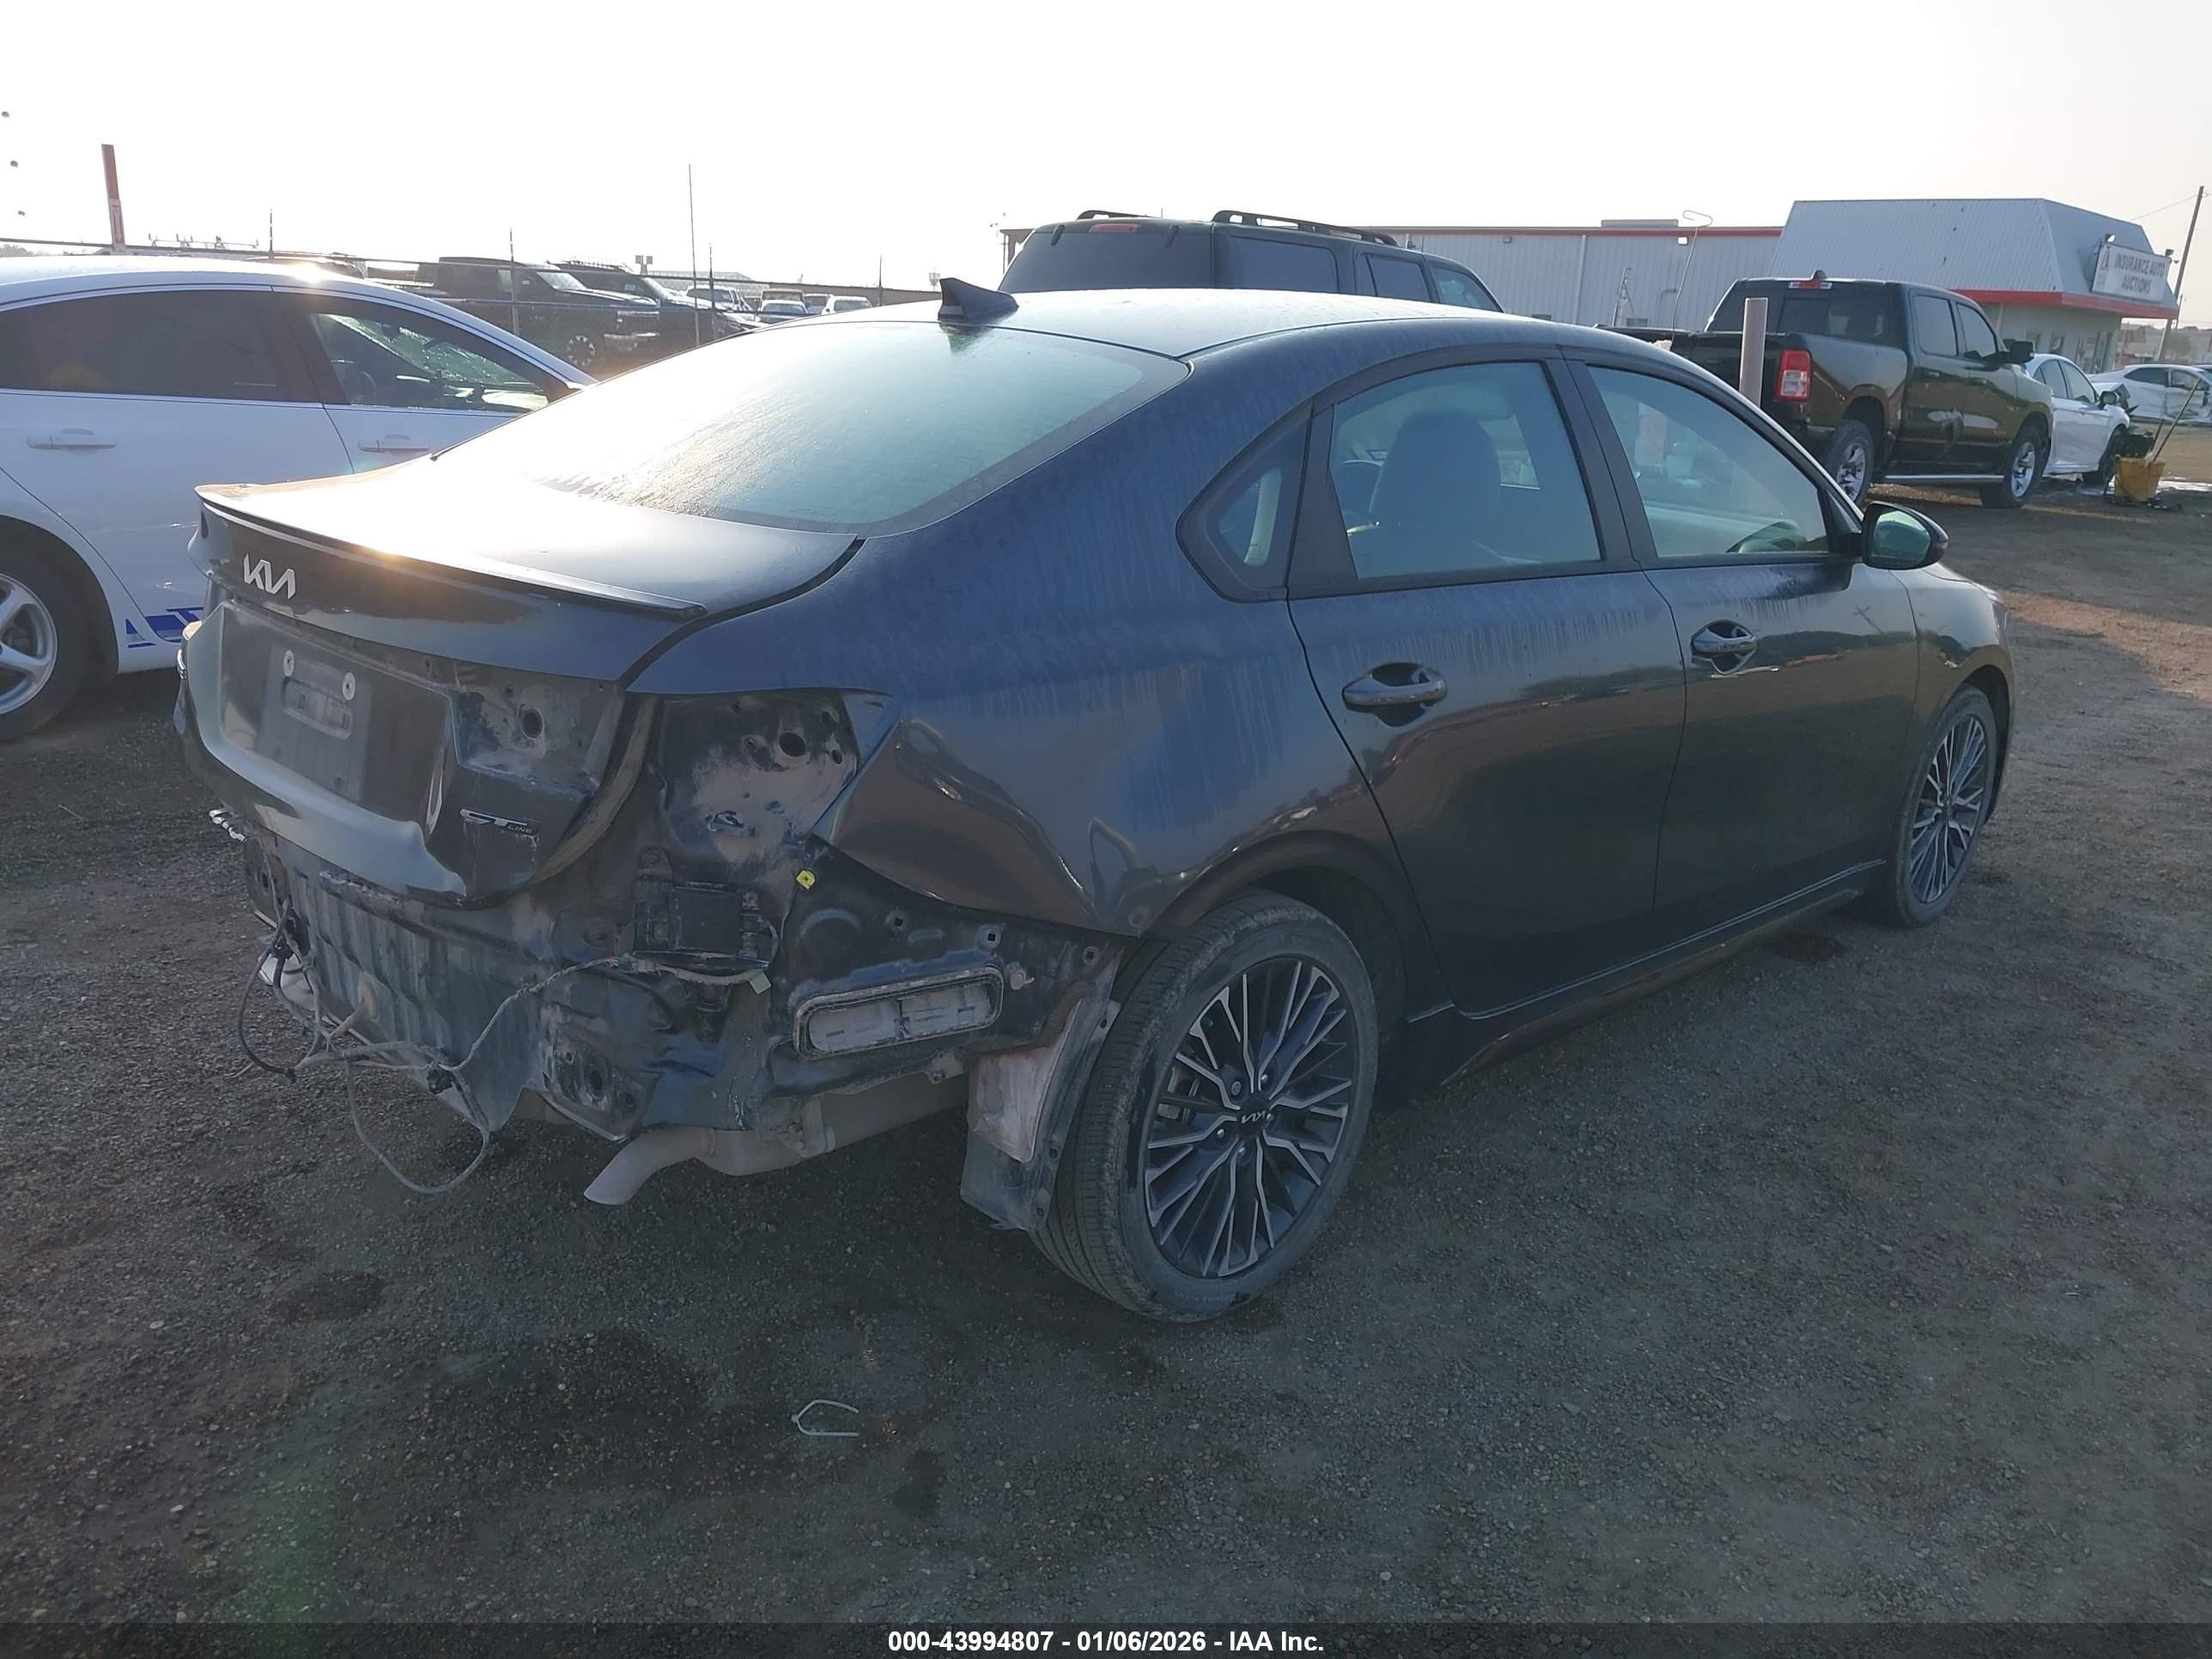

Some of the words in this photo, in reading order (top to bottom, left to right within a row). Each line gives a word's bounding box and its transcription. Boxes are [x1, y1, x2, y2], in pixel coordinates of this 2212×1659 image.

[2114, 252, 2150, 275] INSURANCE
[2148, 260, 2166, 278] AUTO
[2121, 274, 2152, 294] AUCTIONS
[243, 553, 296, 599] KIA
[507, 824, 533, 834] LINE
